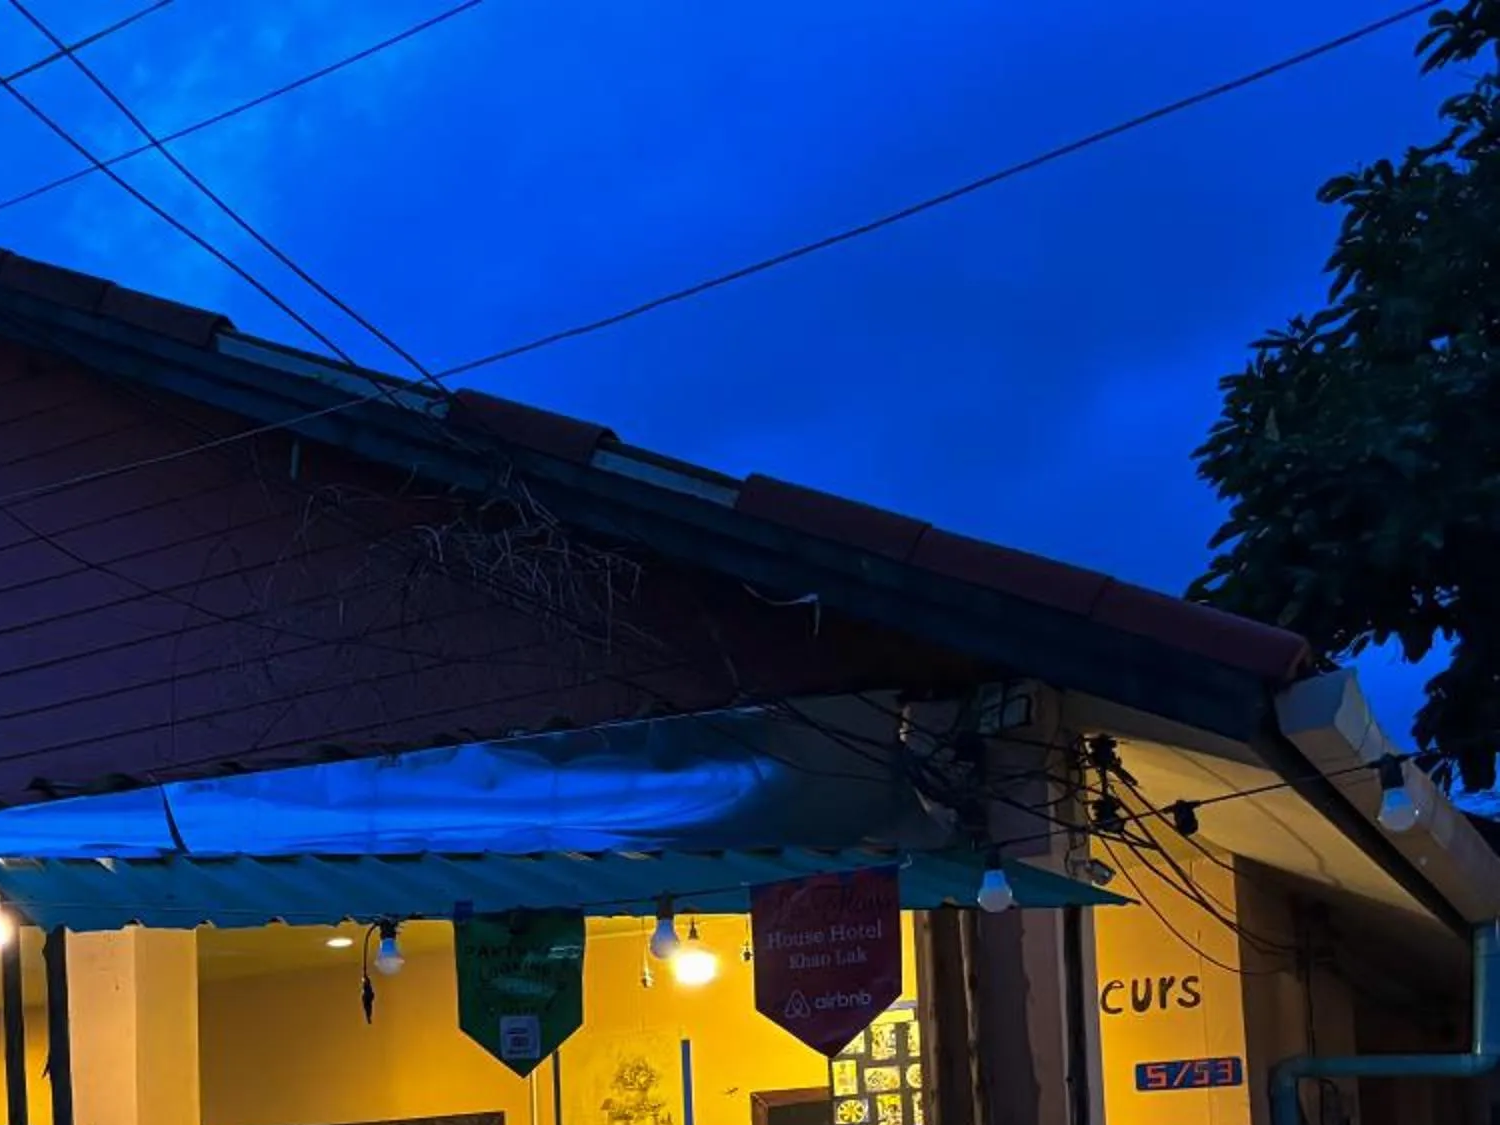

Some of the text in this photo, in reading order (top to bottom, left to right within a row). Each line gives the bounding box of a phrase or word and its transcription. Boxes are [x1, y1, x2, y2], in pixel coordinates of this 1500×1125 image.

[767, 918, 882, 949] House Hotel
[815, 988, 872, 1008] airbnb
[1145, 1060, 1233, 1088] 5/53
